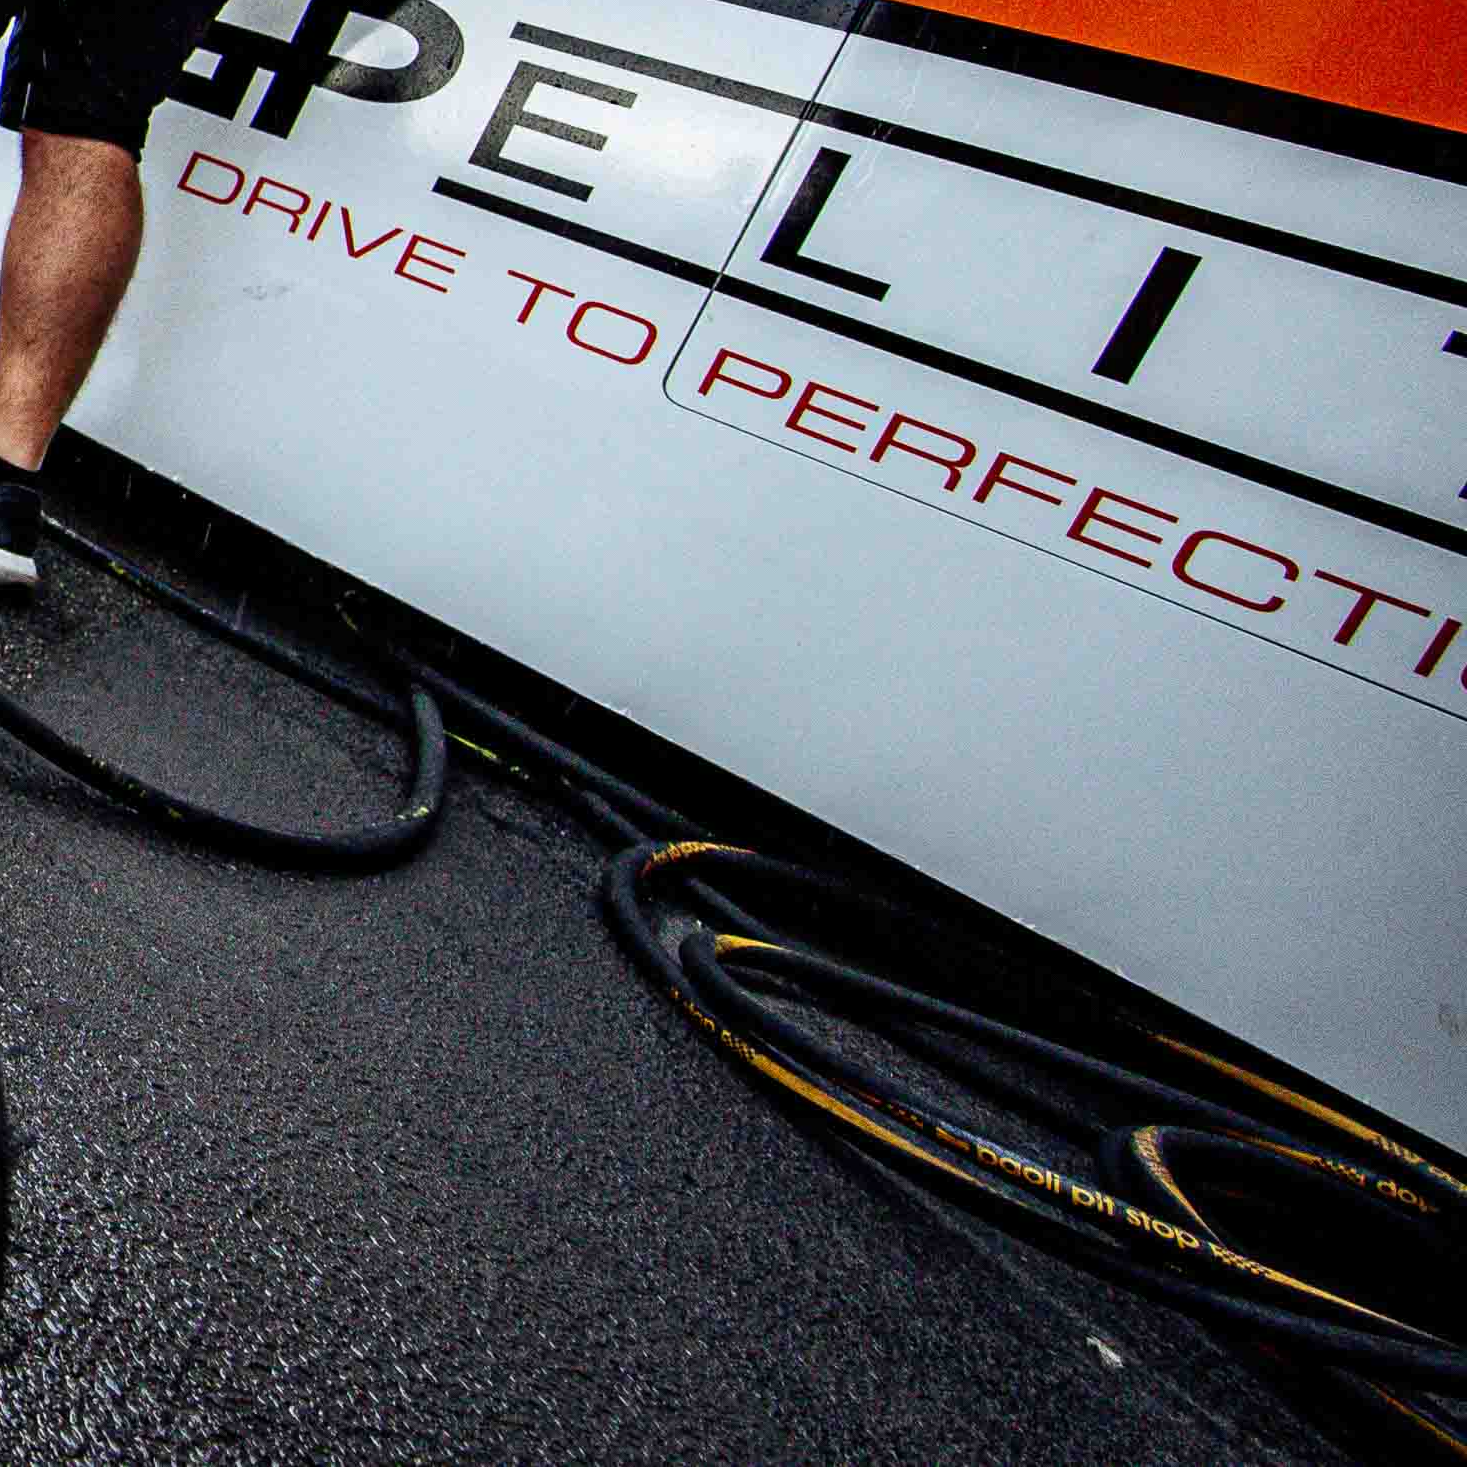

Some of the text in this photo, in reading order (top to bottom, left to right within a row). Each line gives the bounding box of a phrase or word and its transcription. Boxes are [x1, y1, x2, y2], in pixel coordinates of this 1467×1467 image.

[176, 150, 1467, 692] DRIVE TO PERFECTI
[467, 60, 1467, 504] ELI
[1124, 1204, 1201, 1251] stop
